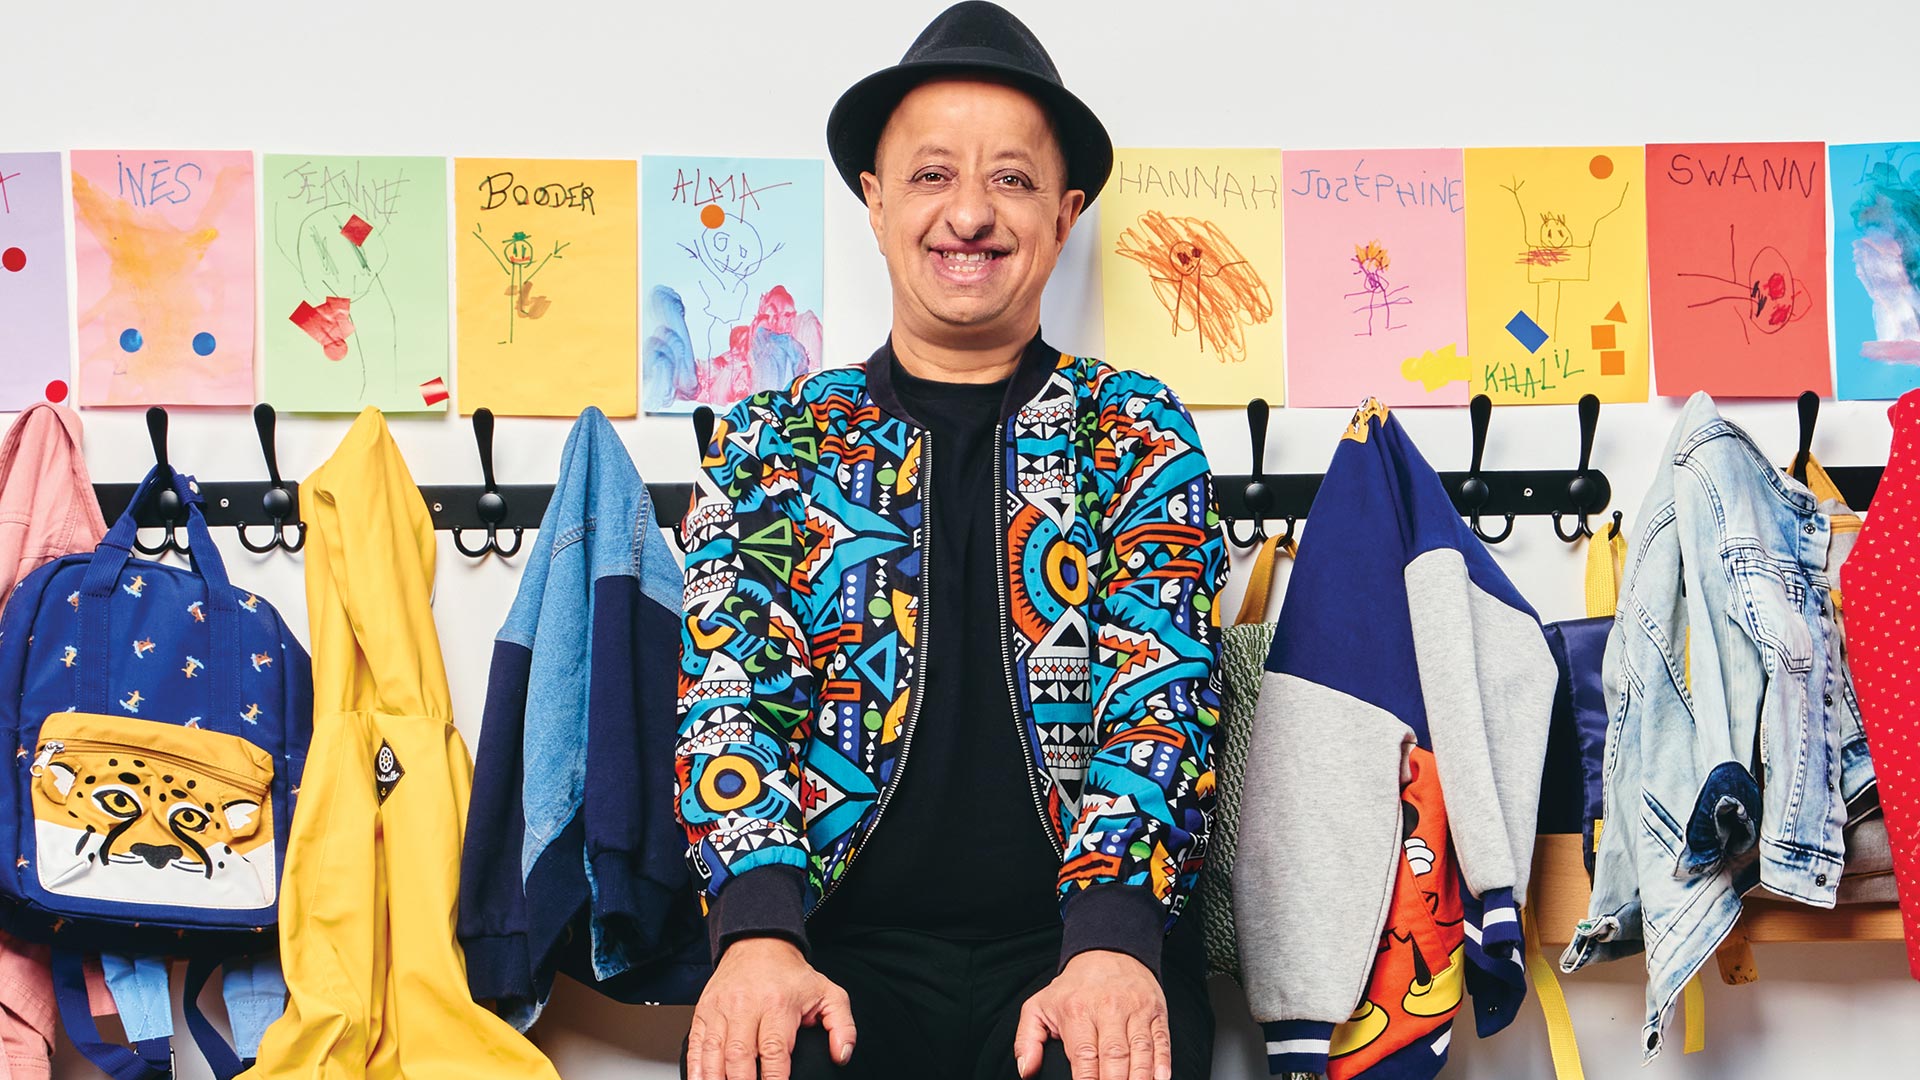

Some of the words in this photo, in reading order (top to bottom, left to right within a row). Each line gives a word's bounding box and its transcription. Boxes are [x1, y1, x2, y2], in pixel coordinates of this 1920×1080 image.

[282, 160, 410, 225] JEANNE
[479, 171, 595, 215] BOODER
[672, 168, 792, 223] ALMA
[1119, 161, 1277, 210] HANNAH
[1667, 154, 1816, 198] SWANN
